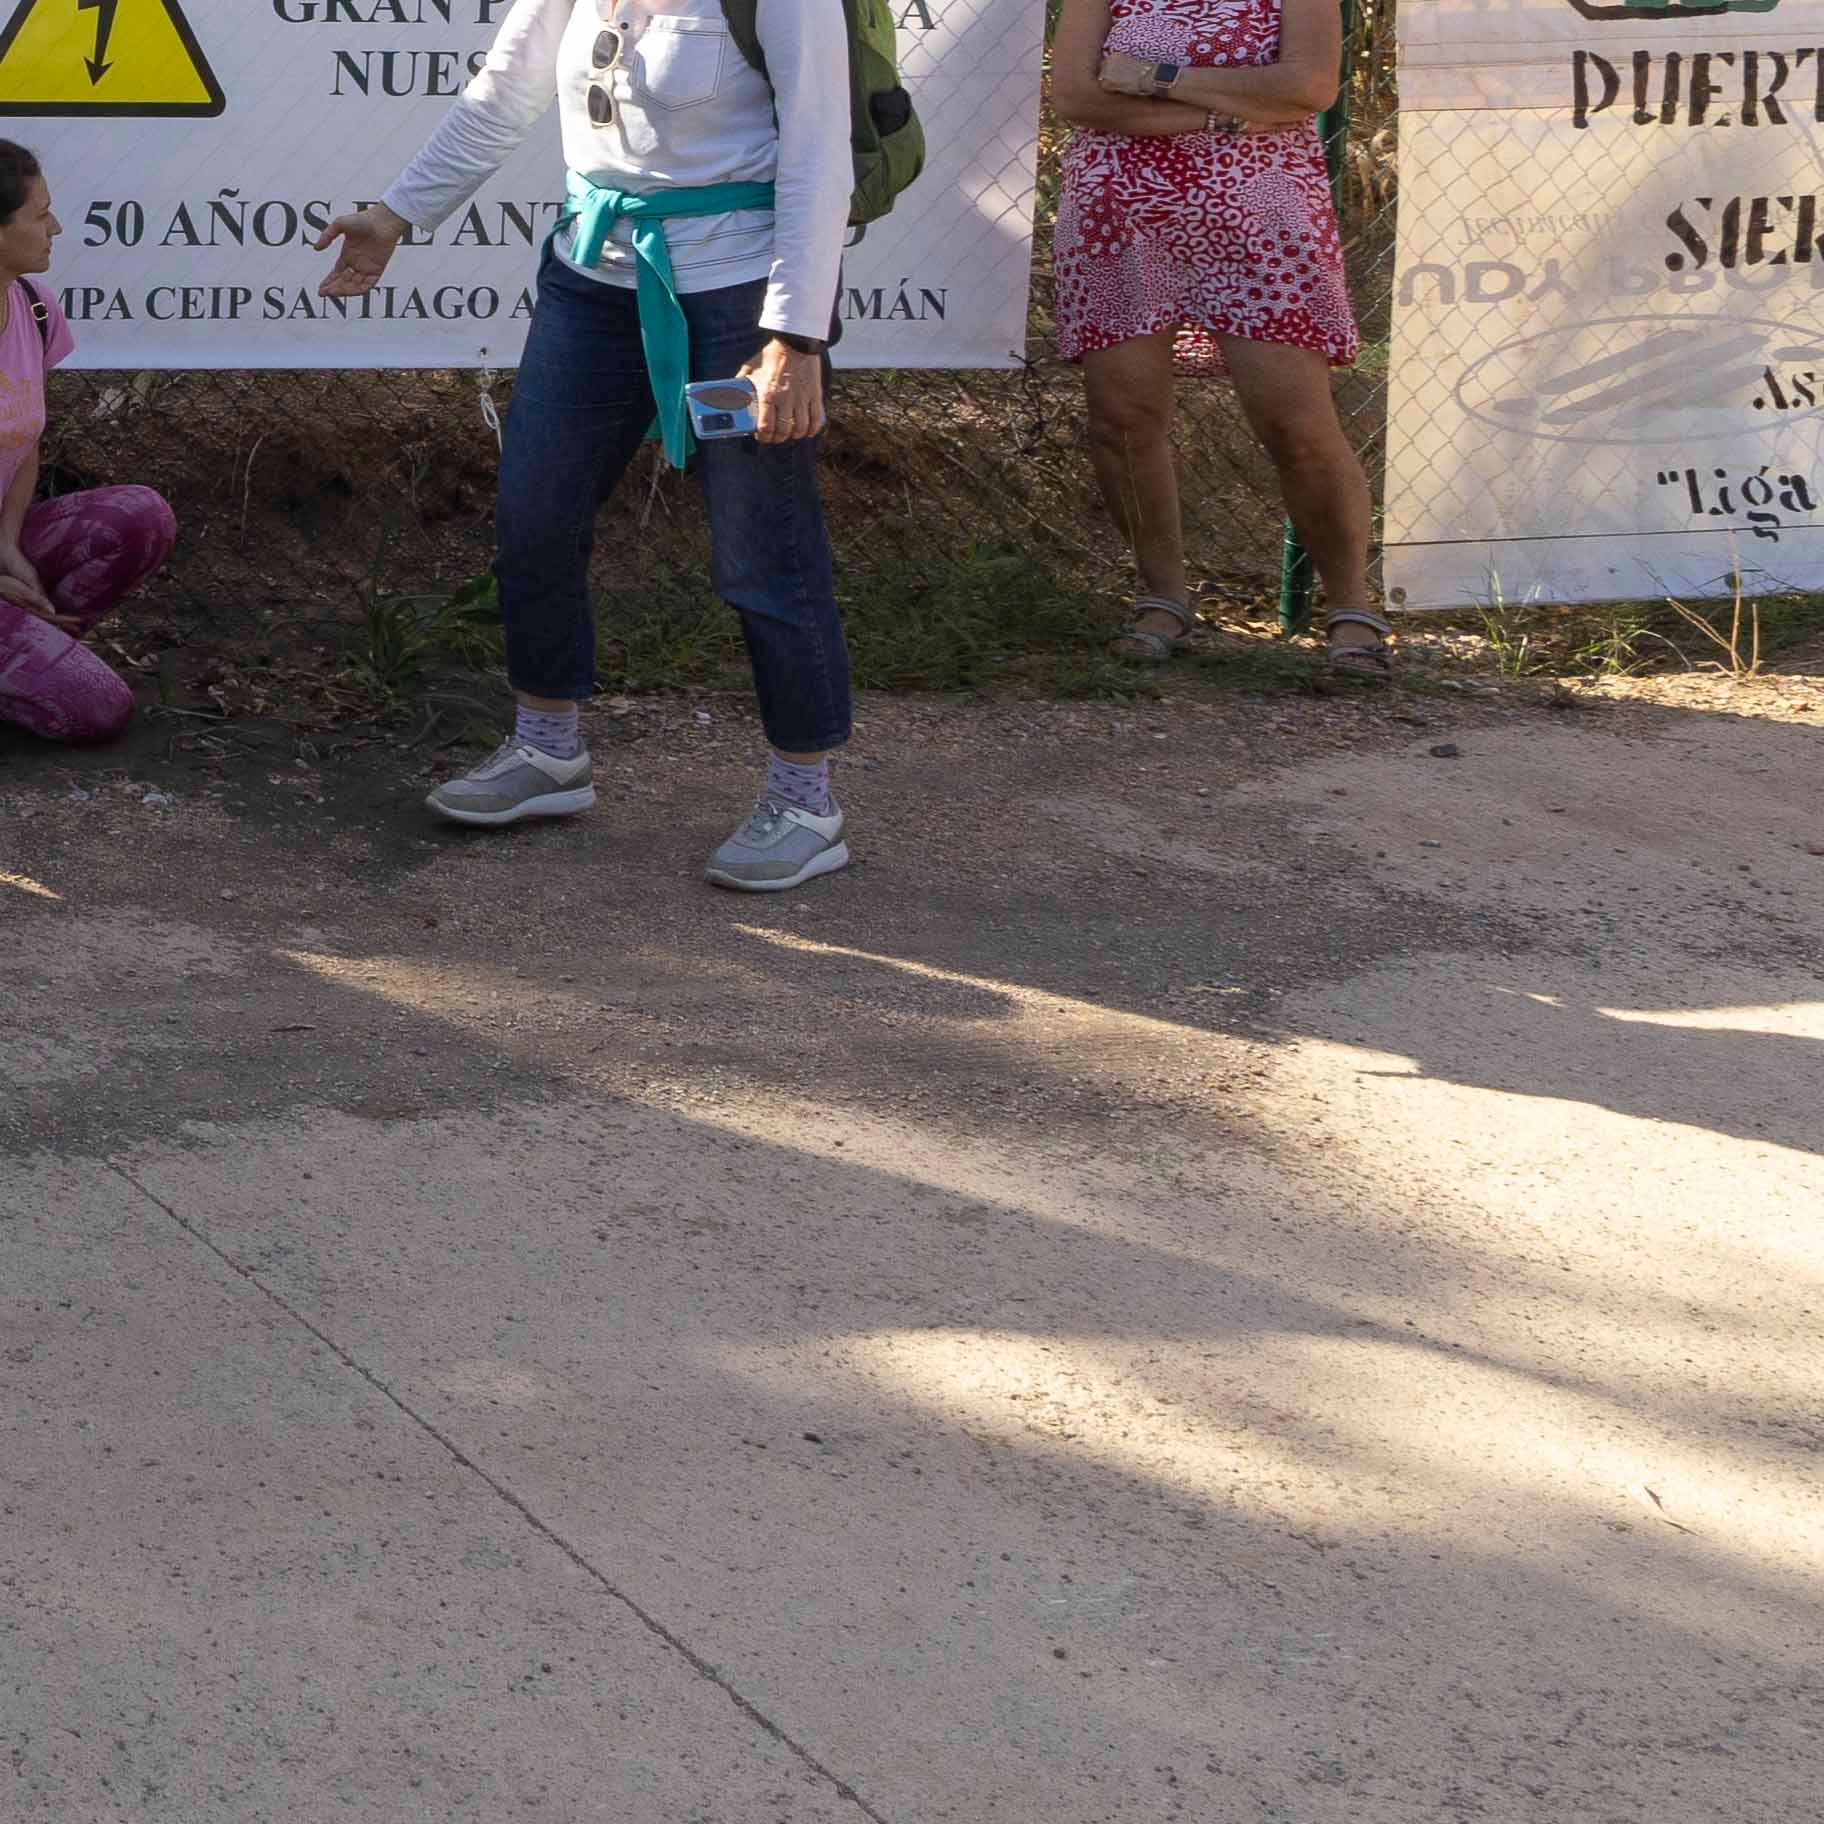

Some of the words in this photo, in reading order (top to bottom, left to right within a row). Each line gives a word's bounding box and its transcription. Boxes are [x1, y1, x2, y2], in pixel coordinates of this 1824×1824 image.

[84, 201, 144, 246] 50
[159, 189, 333, 247] AÑOS
[146, 287, 251, 320] CEIP
[263, 286, 499, 320] SANTIAGO
